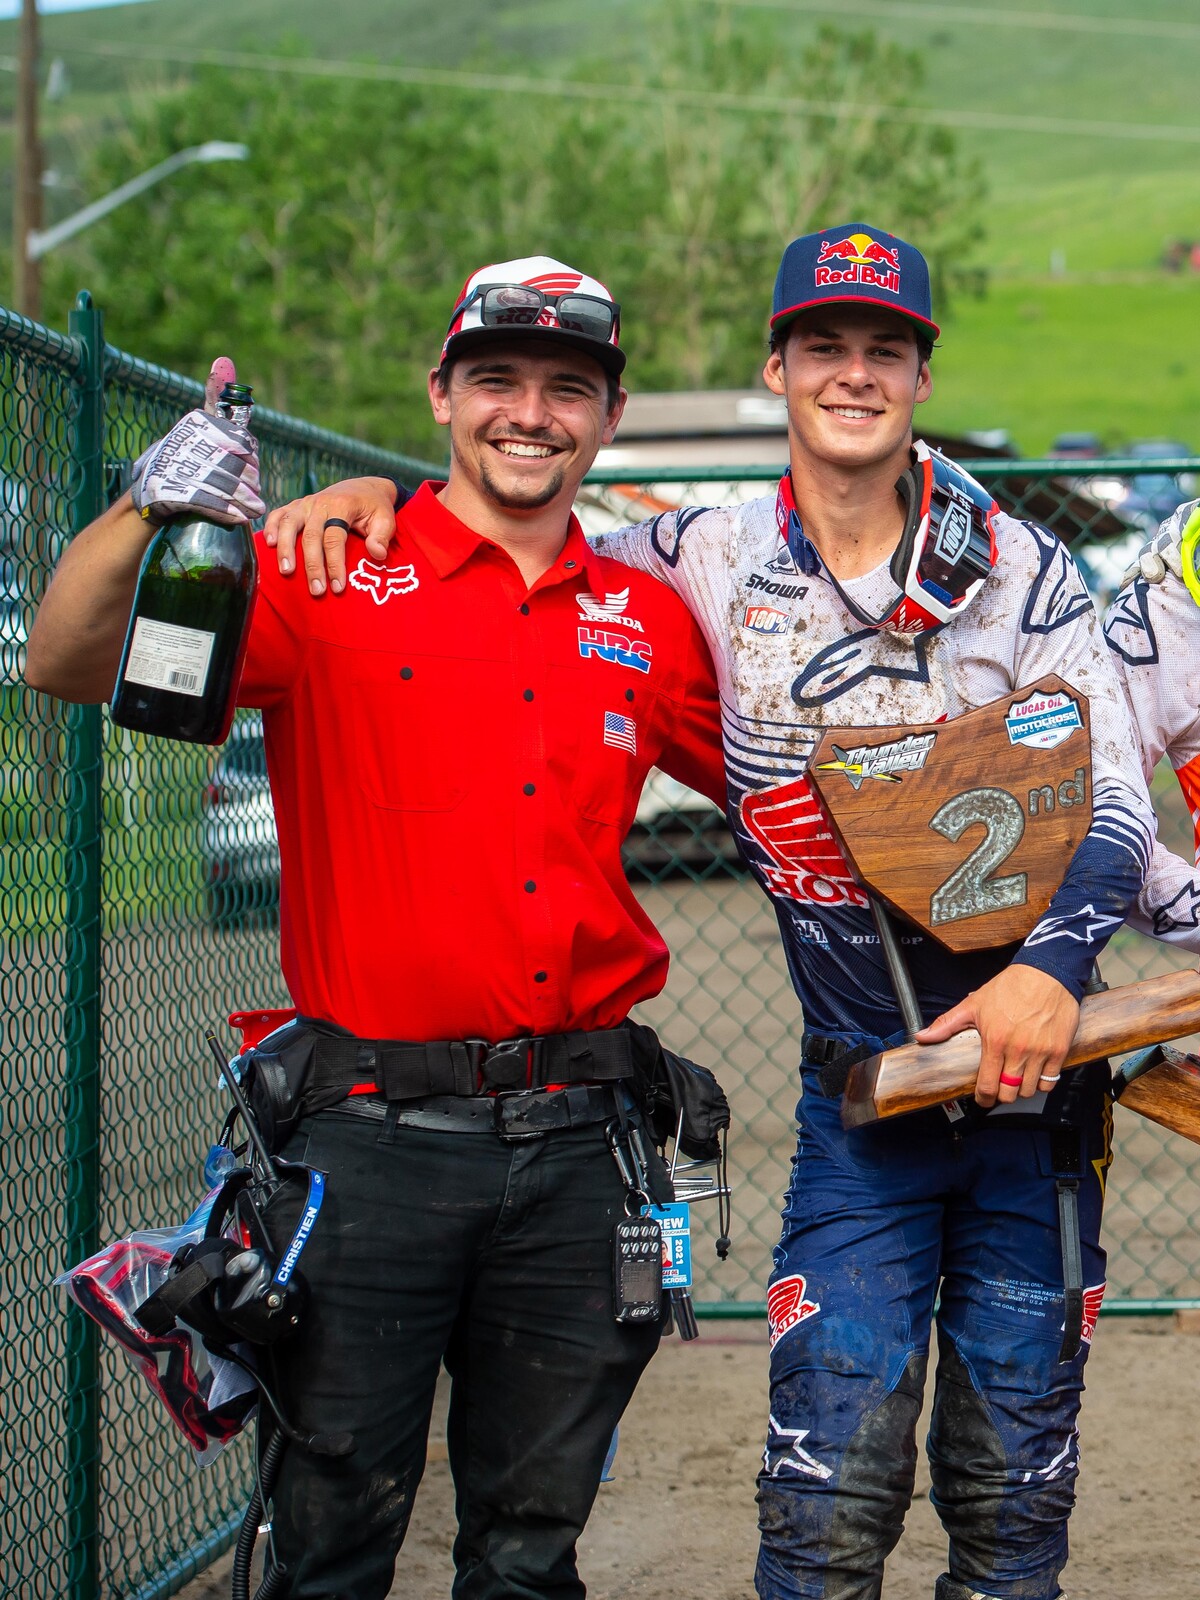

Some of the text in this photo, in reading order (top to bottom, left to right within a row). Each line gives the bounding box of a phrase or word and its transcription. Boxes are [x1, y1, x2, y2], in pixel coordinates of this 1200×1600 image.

[815, 263, 900, 294] Red Bull
[161, 438, 219, 494] Mchnix
[942, 508, 968, 556] 100%
[745, 573, 809, 600] SHOWA
[578, 612, 645, 633] HONDA
[748, 608, 789, 634] 100%
[578, 626, 653, 674] HRC
[1015, 700, 1046, 717] LUCAS
[1010, 711, 1077, 735] MOTOCROSS
[845, 733, 937, 767] Thunder
[862, 751, 927, 778] Valley
[928, 767, 1086, 928] 2nd
[850, 935, 924, 945] DUOP
[658, 1217, 684, 1230] REW
[277, 1206, 318, 1283] CHRISTIEN
[675, 1239, 684, 1265] 2021
[662, 1276, 688, 1284] OCROSS
